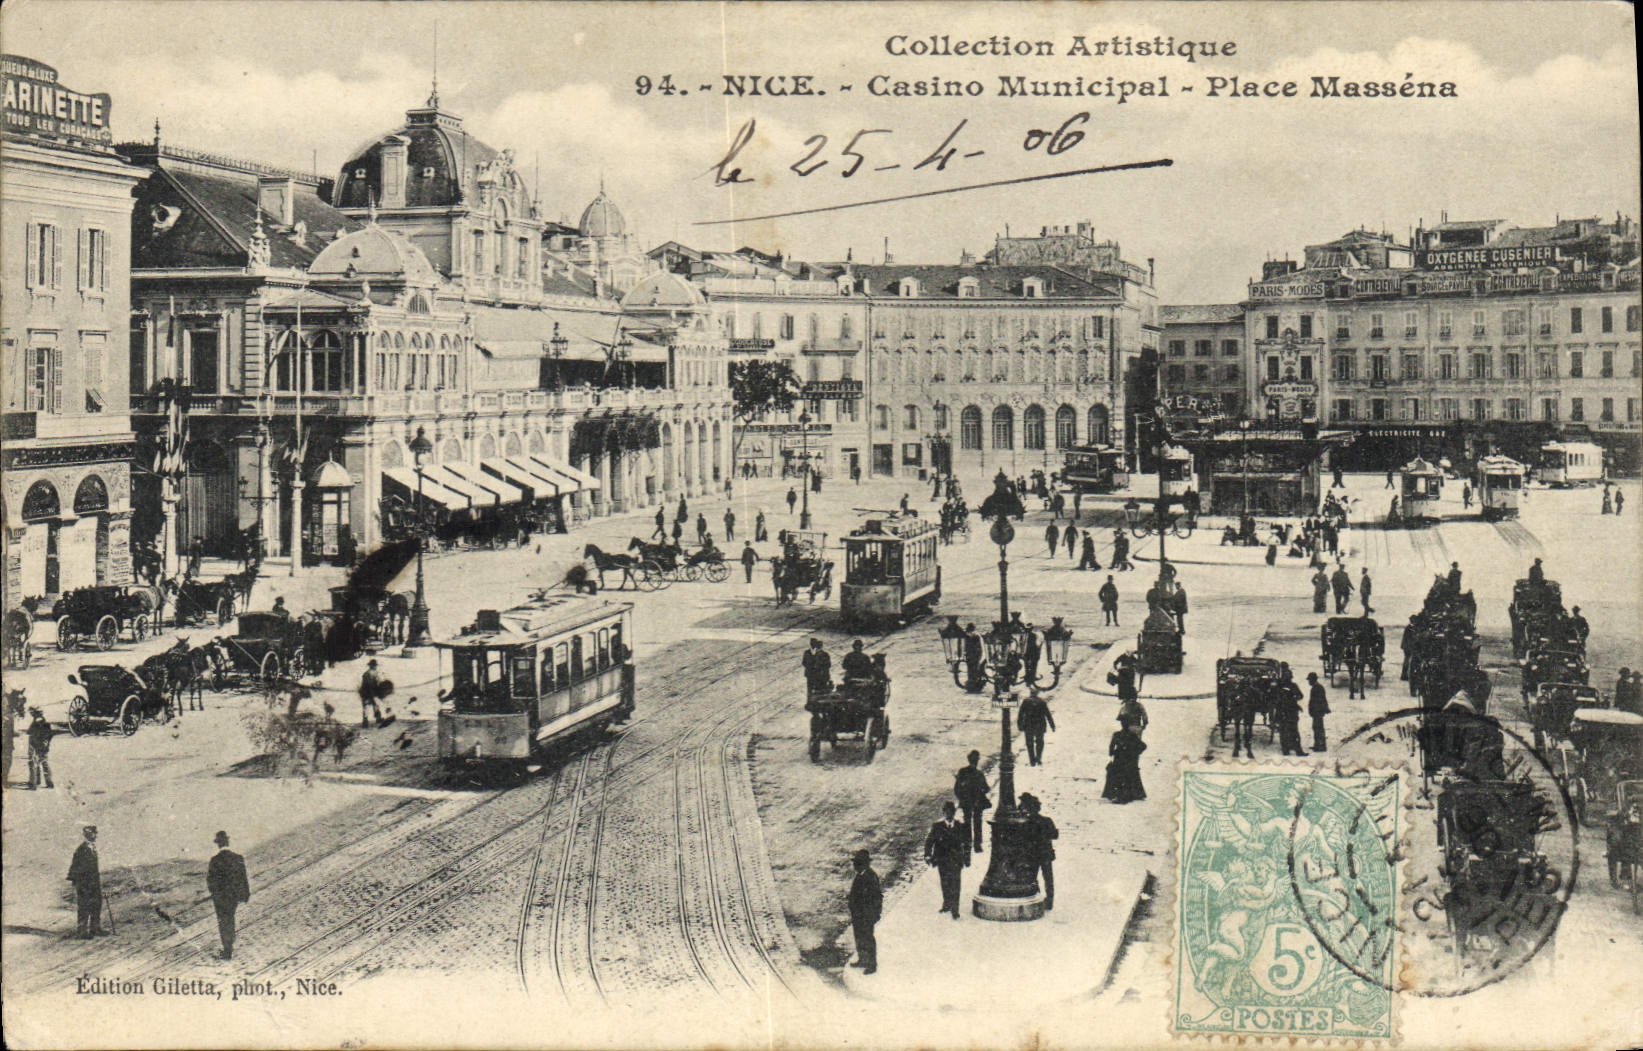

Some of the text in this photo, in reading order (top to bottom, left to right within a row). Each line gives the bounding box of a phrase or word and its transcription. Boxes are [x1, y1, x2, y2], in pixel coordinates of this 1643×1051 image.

[36, 66, 55, 83] LUXE
[3, 79, 103, 126] ARINETTE
[6, 112, 30, 127] TOUS
[1427, 247, 1551, 265] OXYGENEE CUSENIER
[1236, 1008, 1330, 1032] POSTES
